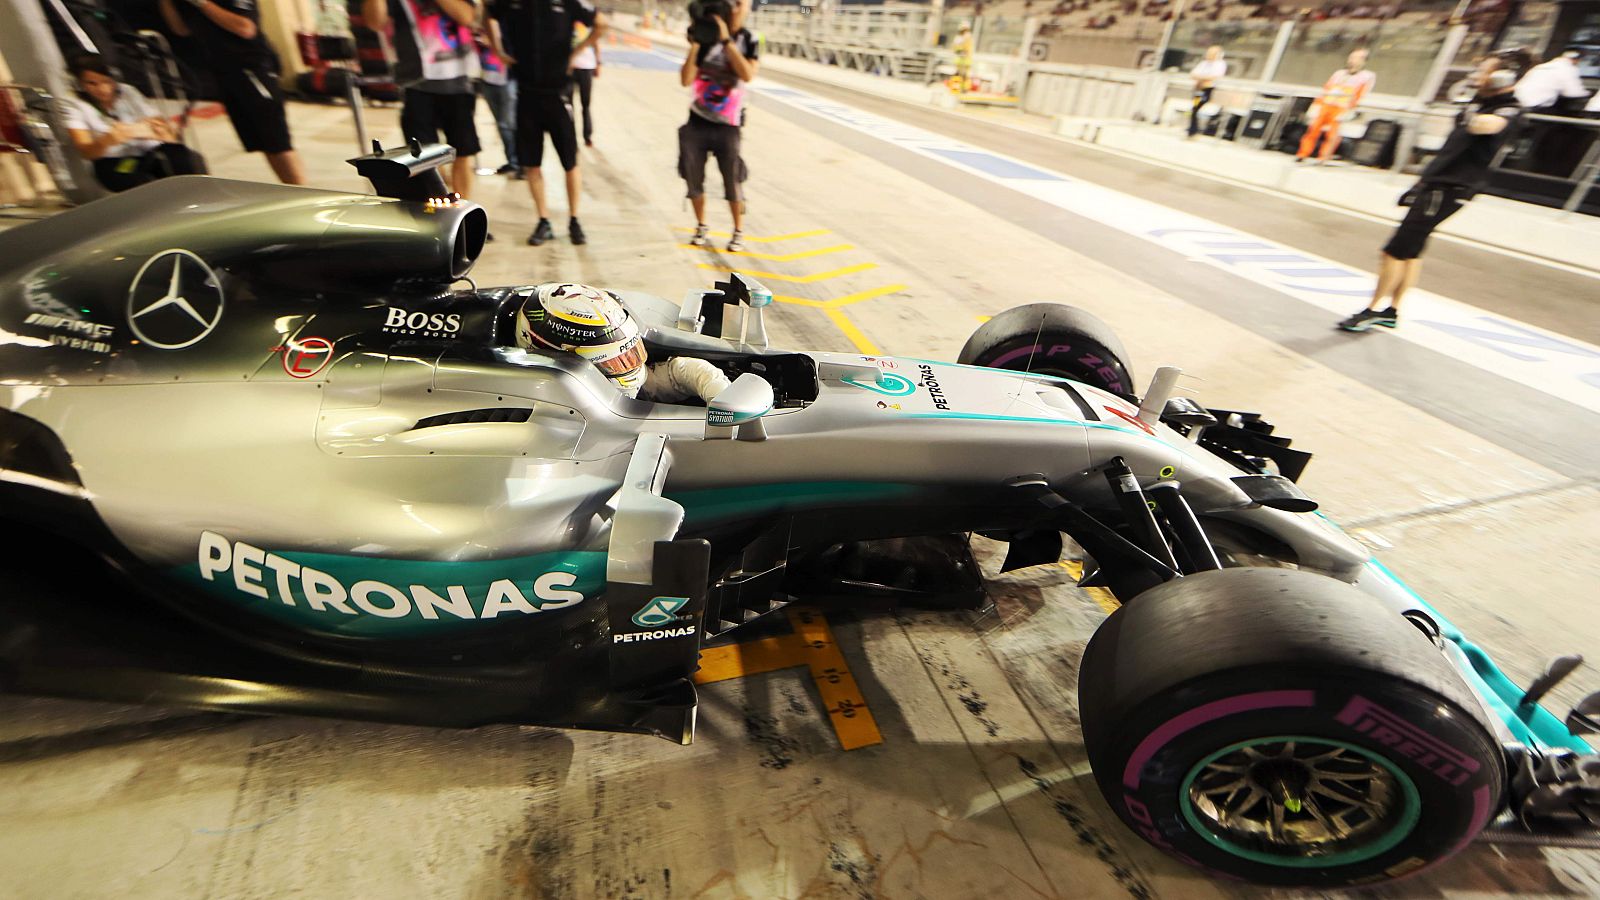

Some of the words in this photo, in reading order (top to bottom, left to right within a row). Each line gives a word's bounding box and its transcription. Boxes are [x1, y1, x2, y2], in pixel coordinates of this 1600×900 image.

[54, 317, 116, 337] AMG
[384, 307, 461, 333] BOSS
[547, 319, 597, 338] MONSTER
[382, 327, 416, 335] HUGO
[423, 331, 457, 339] BOSS
[918, 364, 951, 411] PETRONAS
[198, 529, 584, 620] PETRONAS
[613, 625, 696, 644] PETRONAS
[1334, 694, 1481, 786] PIRELLI
